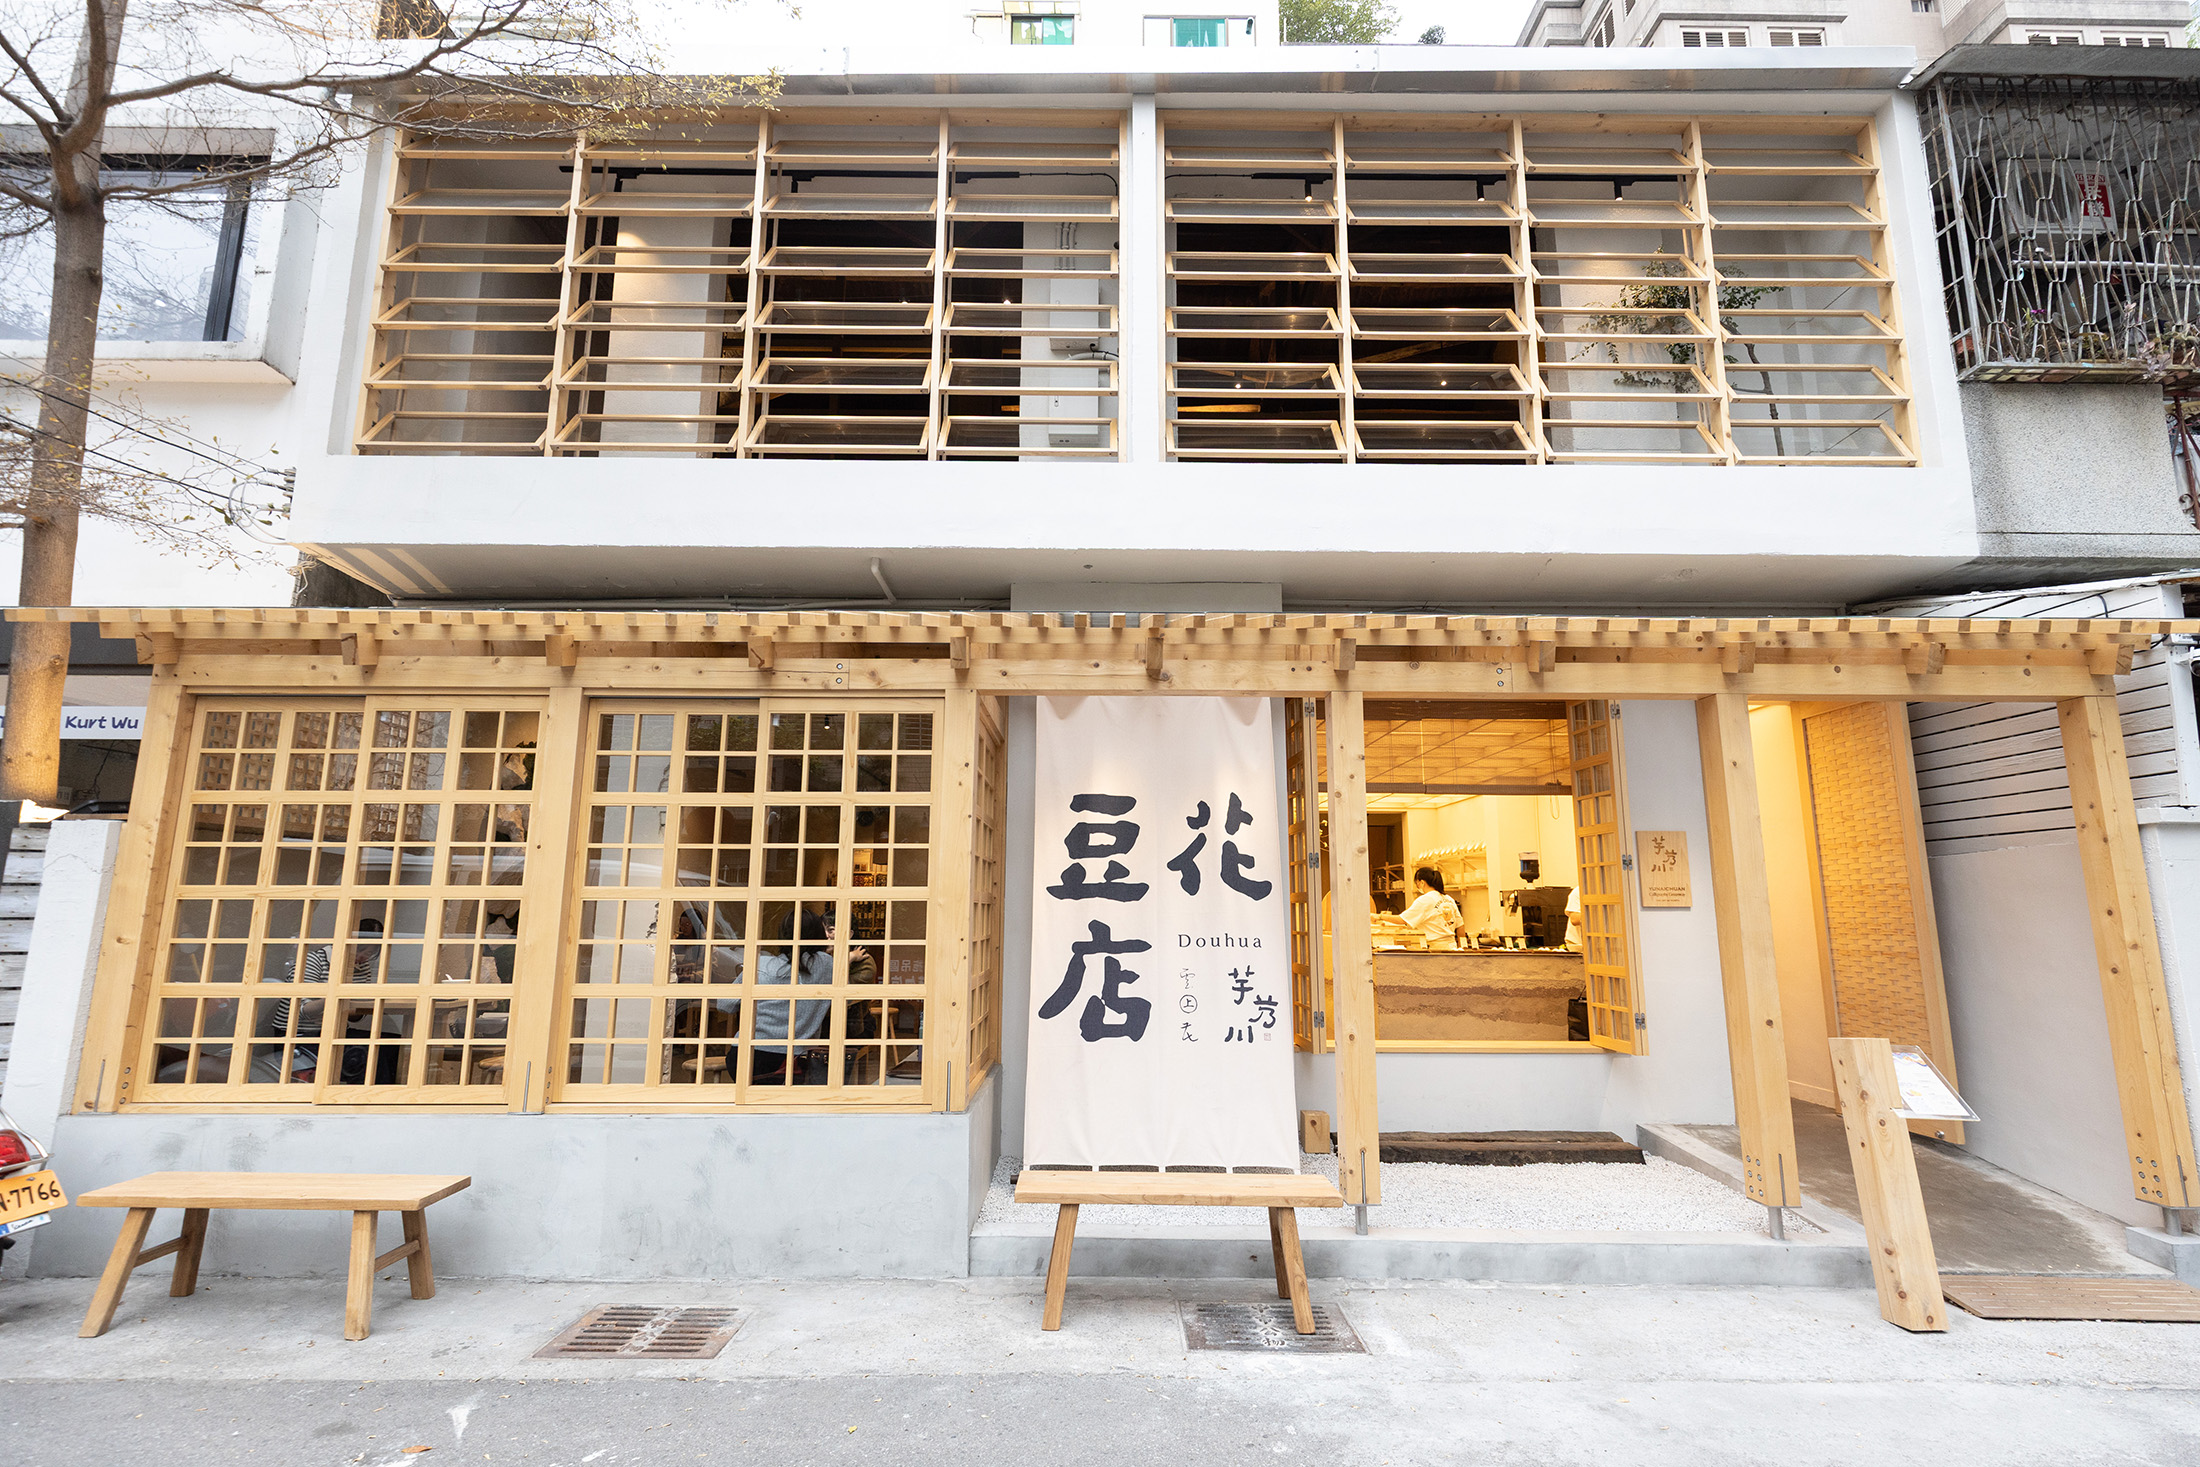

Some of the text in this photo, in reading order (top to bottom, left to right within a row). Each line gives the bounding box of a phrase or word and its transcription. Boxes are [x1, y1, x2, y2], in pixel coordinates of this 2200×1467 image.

[65, 715, 139, 729] Kurt Wu
[1178, 932, 1262, 949] Douhua
